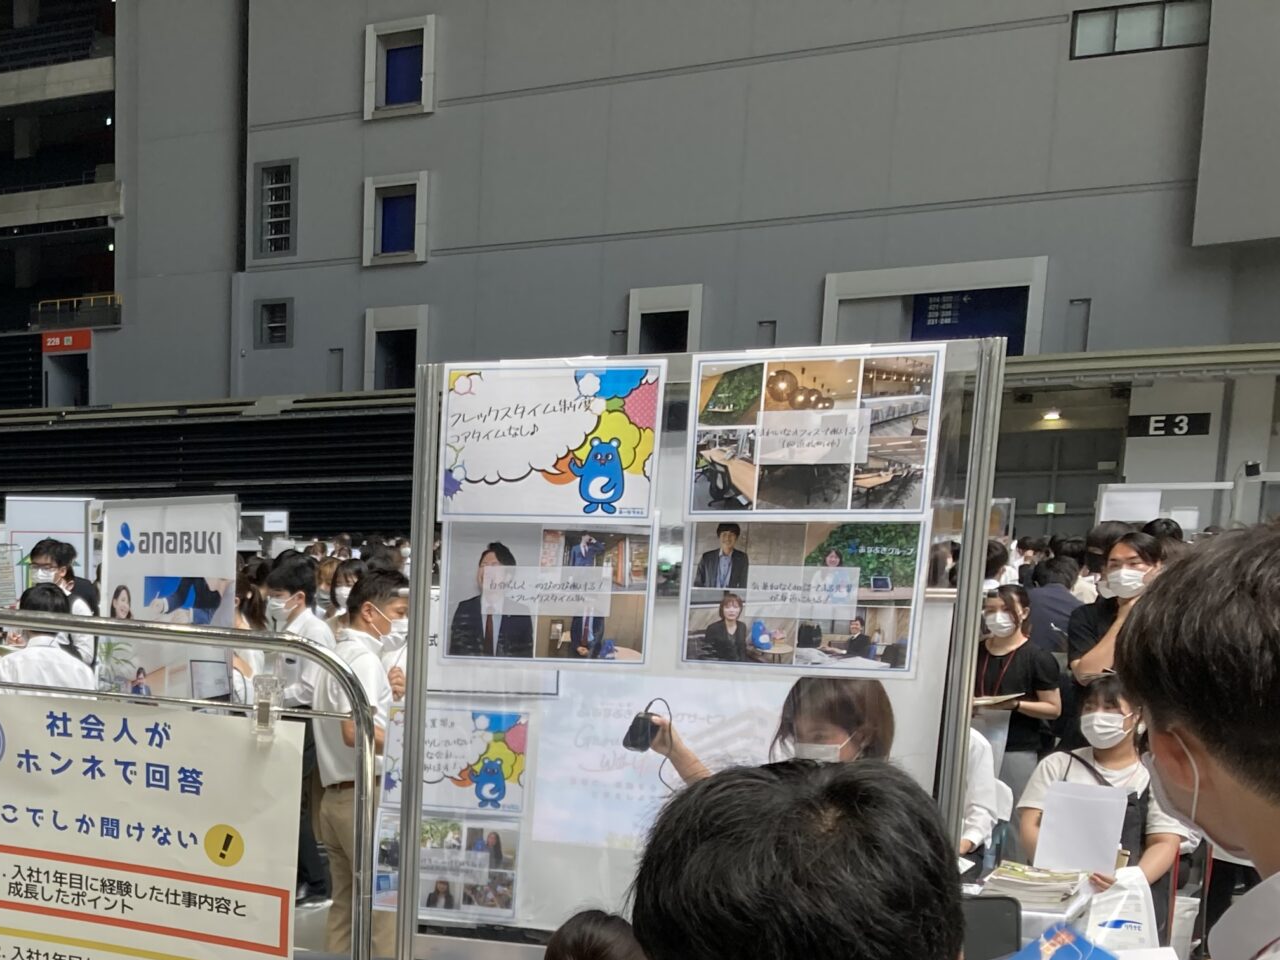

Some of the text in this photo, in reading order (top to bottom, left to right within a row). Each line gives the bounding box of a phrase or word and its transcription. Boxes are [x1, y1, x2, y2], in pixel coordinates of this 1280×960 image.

[46, 711, 171, 749] 社会人が
[17, 749, 203, 796] ホンネで回答
[8, 881, 134, 914] 成長したポイント
[11, 864, 247, 917] 入社1年目に経験した仕事内容と
